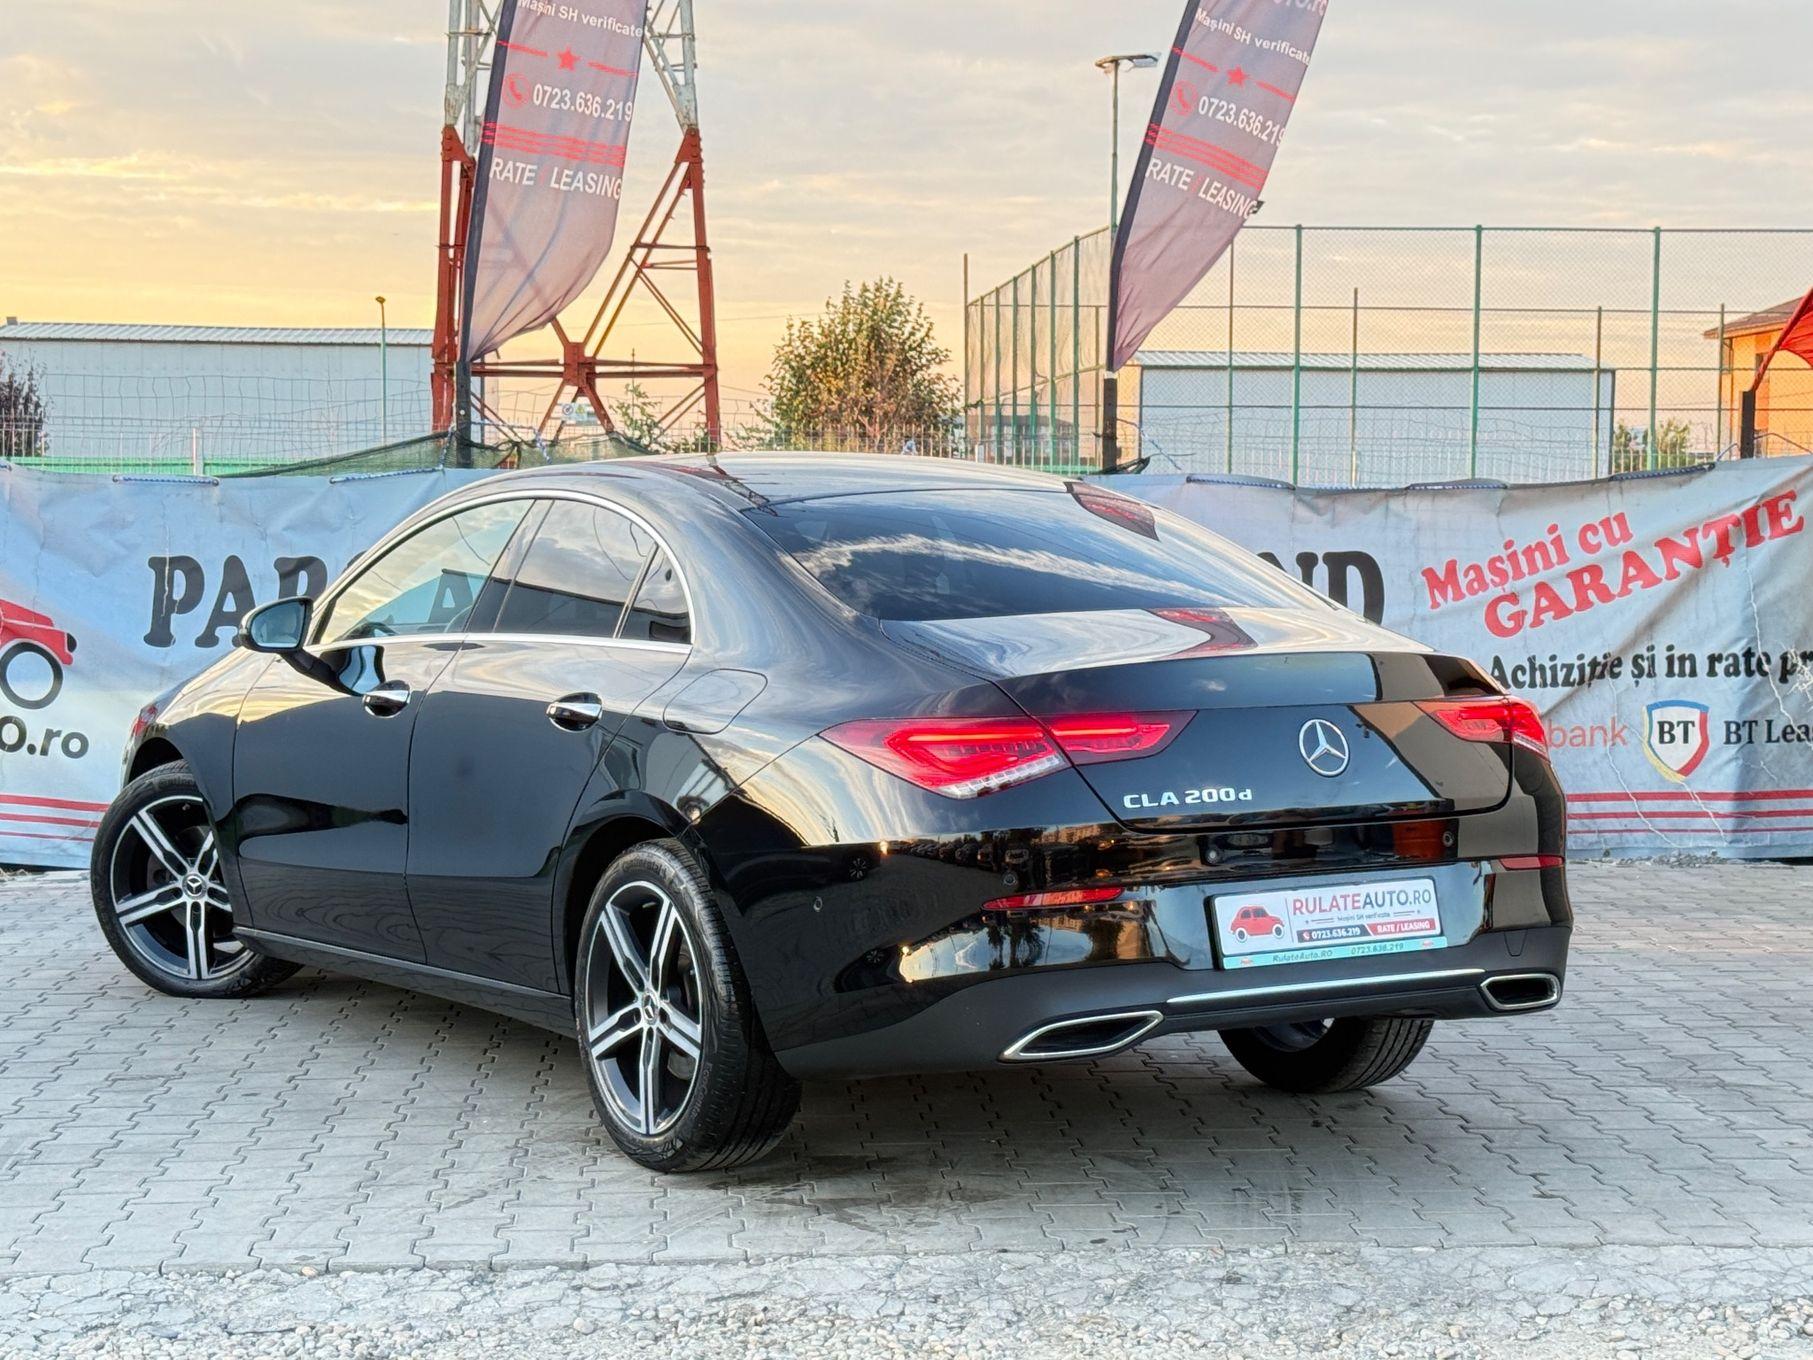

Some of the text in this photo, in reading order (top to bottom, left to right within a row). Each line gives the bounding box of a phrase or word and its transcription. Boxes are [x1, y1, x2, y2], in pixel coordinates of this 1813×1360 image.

[558, 6, 578, 22] SH
[581, 13, 643, 37] verificate
[1234, 27, 1251, 45] SH
[532, 84, 633, 122] 0723.636.219
[1198, 96, 1287, 147] 0723.636.219
[489, 158, 537, 186] RATE
[550, 167, 622, 200] LEASING
[1145, 157, 1194, 190] RATE
[1198, 177, 1258, 220] LEASING
[1421, 524, 1569, 609] Mașini
[1578, 512, 1633, 555] cu
[1484, 489, 1805, 638] GARANȚIE
[1490, 651, 1623, 690] Achiziție
[1631, 645, 1657, 687] și
[1666, 645, 1697, 678] in
[1706, 647, 1771, 678] rate
[1548, 716, 1628, 749] bank
[1657, 720, 1695, 744] BT
[1724, 719, 1813, 745] BT Lea
[1123, 791, 1180, 809] CLA
[1292, 889, 1432, 916] RULATEAUTO.RO
[1311, 927, 1361, 940] 0723.636.219
[1376, 923, 1395, 934] RATE
[1401, 920, 1430, 931] LEASING
